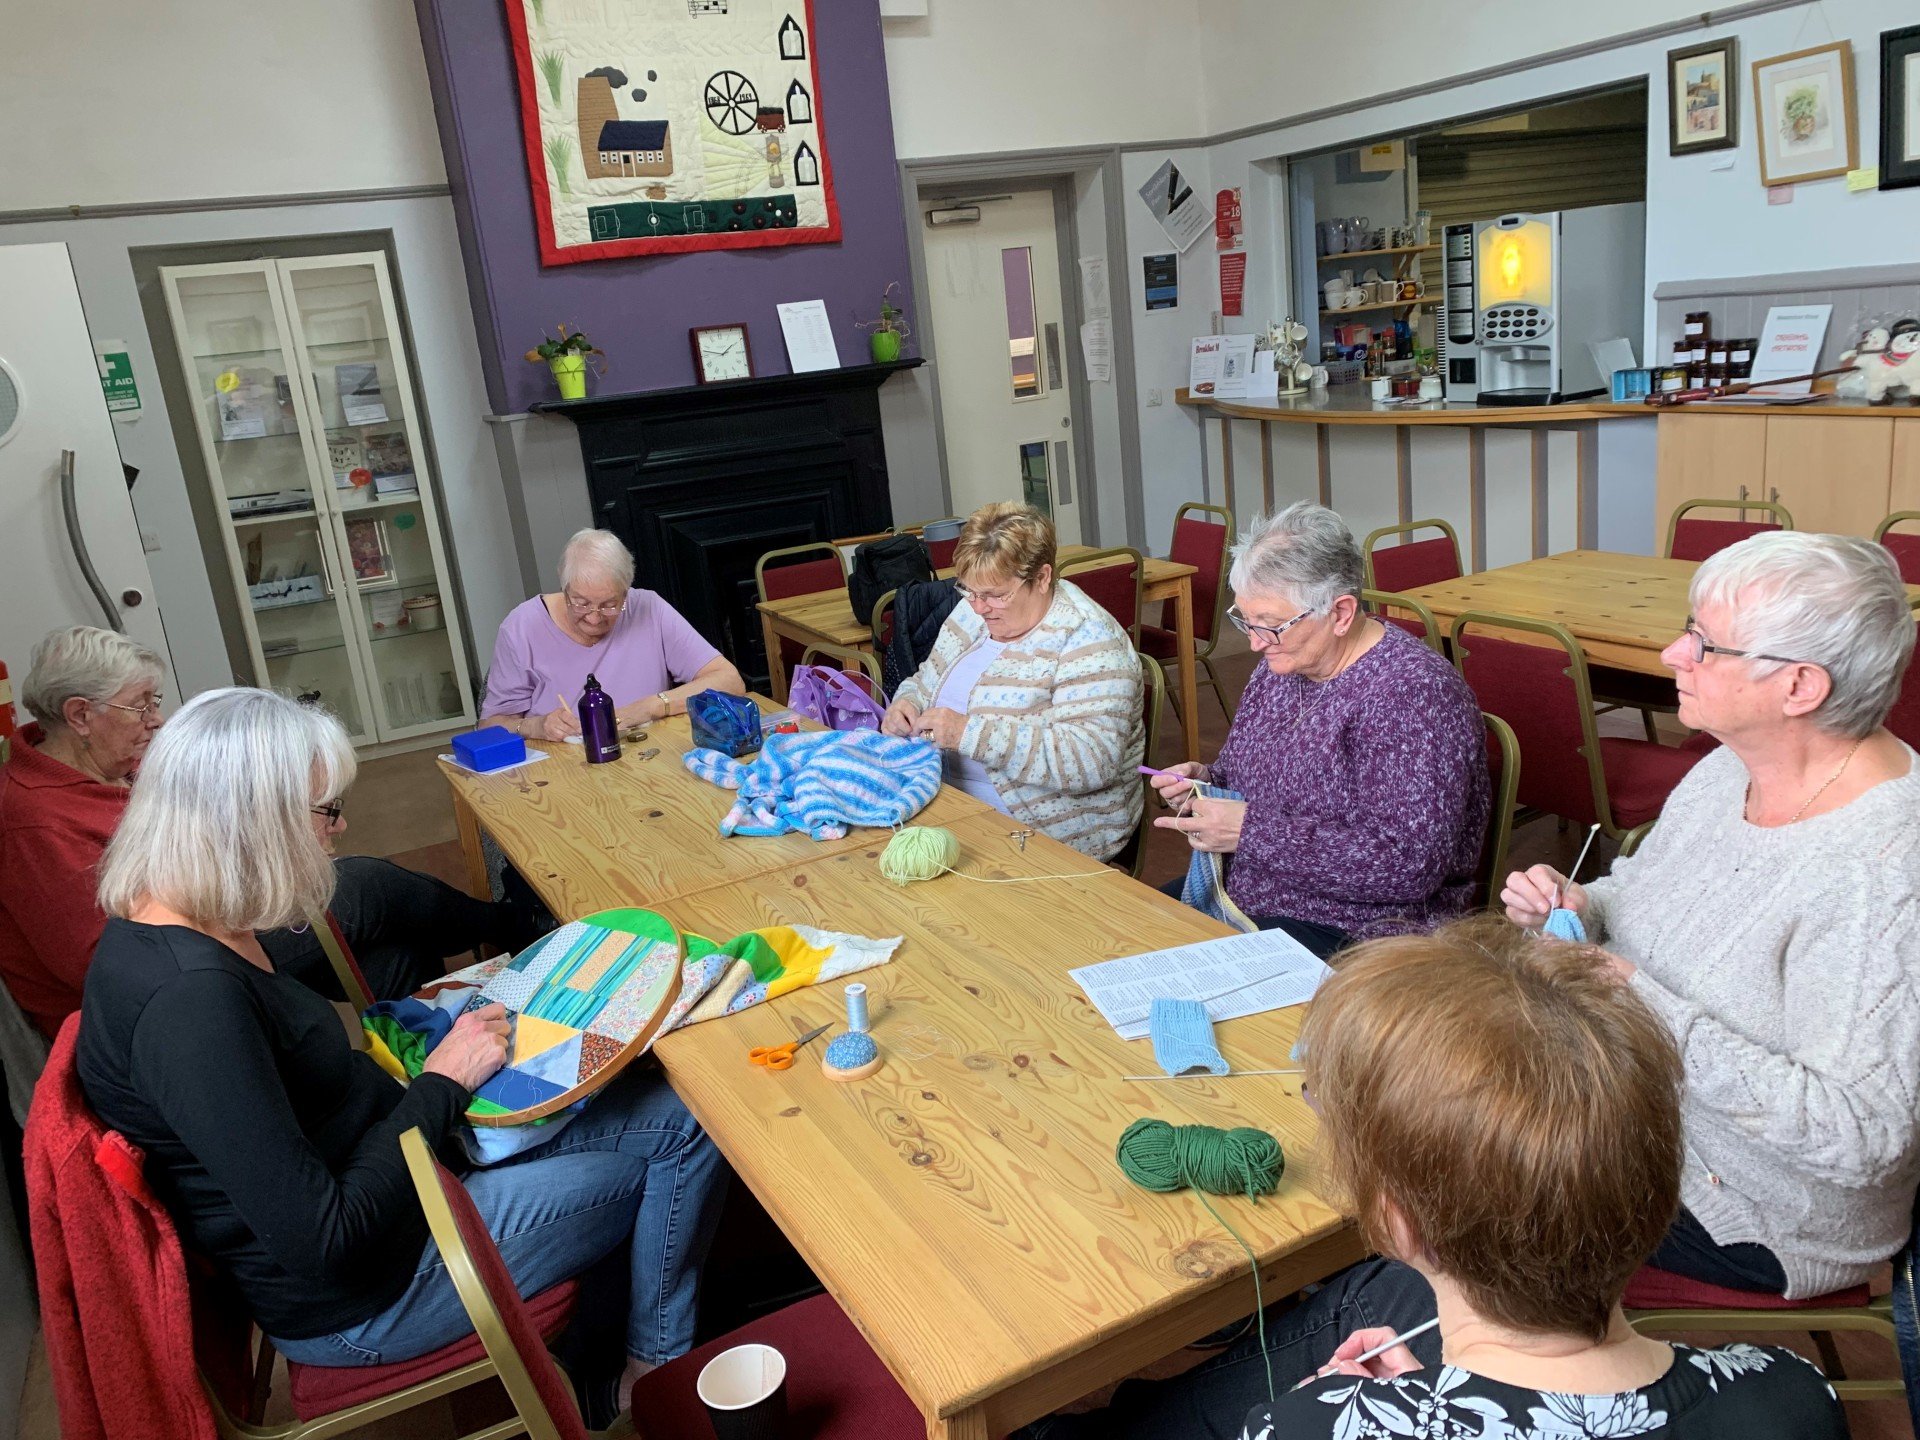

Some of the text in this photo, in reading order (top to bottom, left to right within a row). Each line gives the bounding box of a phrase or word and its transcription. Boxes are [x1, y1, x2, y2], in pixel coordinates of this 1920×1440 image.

[1231, 206, 1241, 218] 18
[1195, 343, 1214, 354] Breakfast
[115, 377, 133, 386] AID
